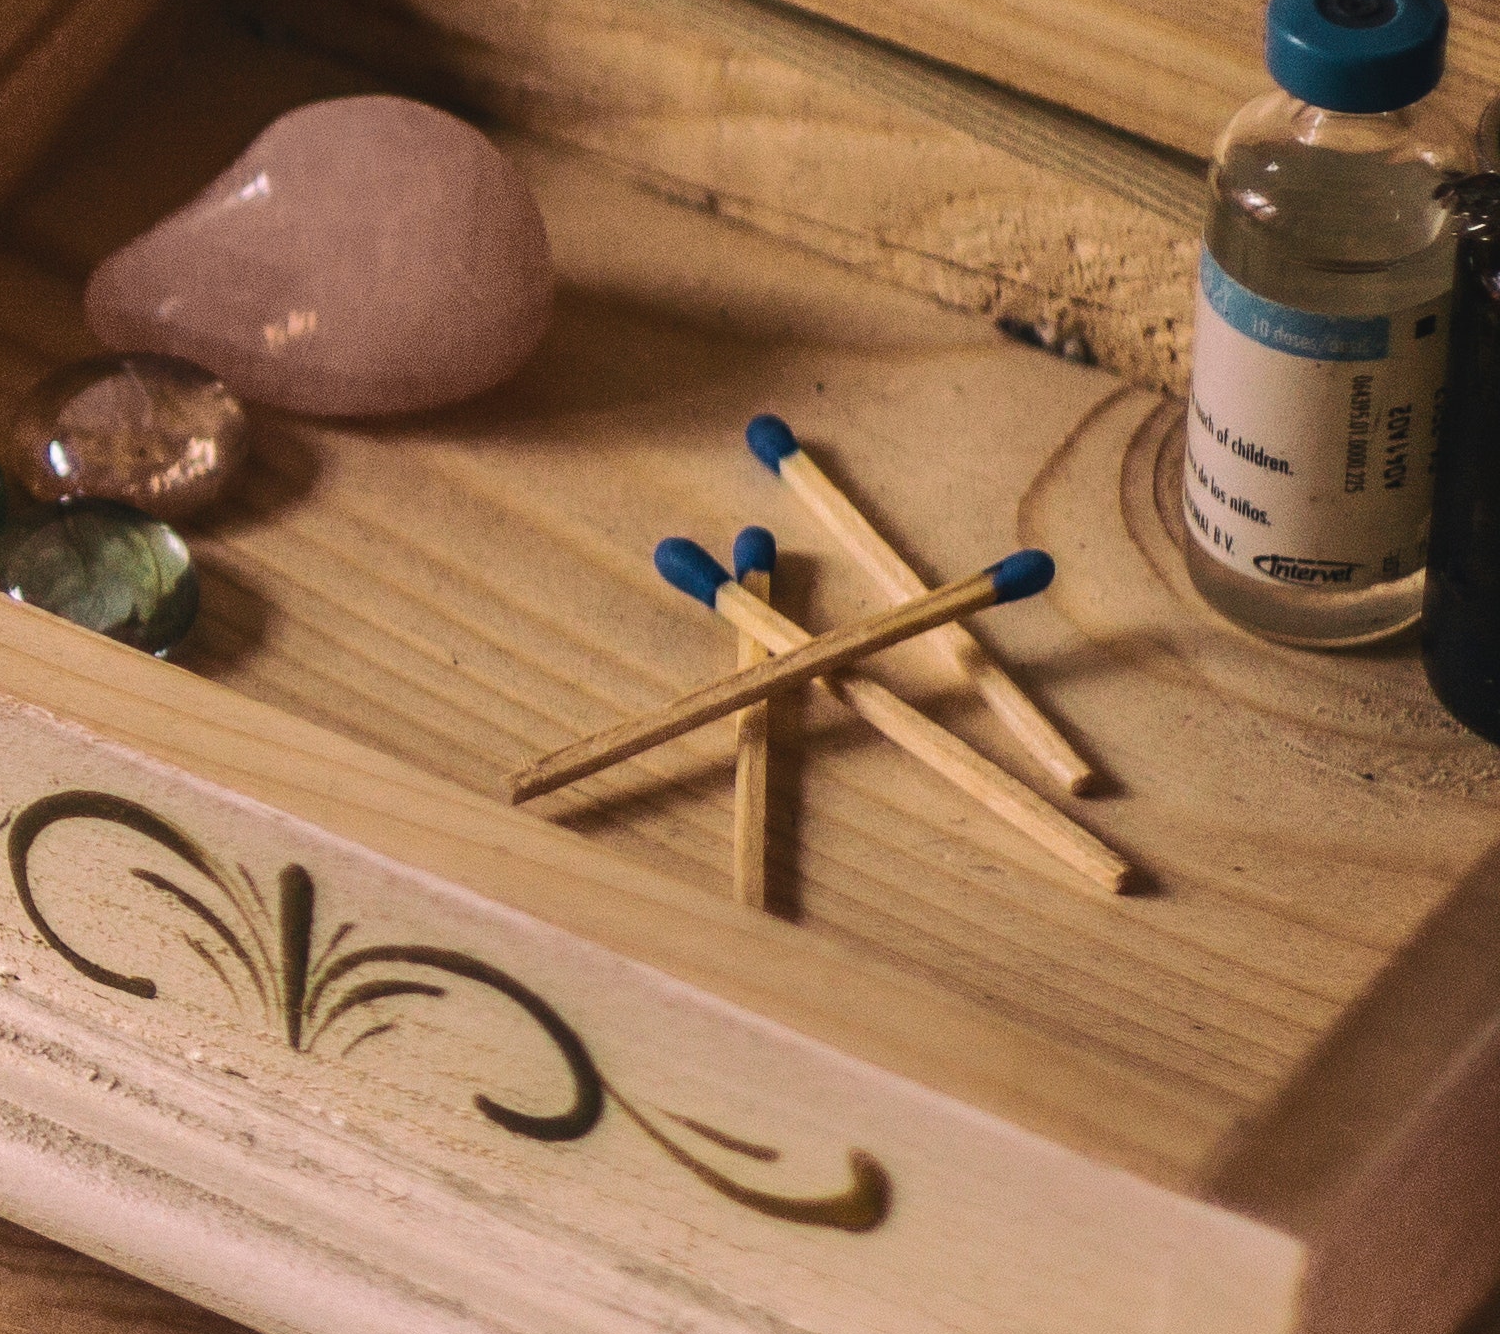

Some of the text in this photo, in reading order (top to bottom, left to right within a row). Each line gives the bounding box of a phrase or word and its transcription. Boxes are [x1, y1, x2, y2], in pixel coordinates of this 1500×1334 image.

[1217, 428, 1229, 447] of
[1231, 437, 1294, 476] children.
[1211, 476, 1227, 504] los
[1230, 497, 1271, 526] niños.
[1213, 526, 1235, 555] B.V.
[1268, 554, 1355, 583] Intervet
